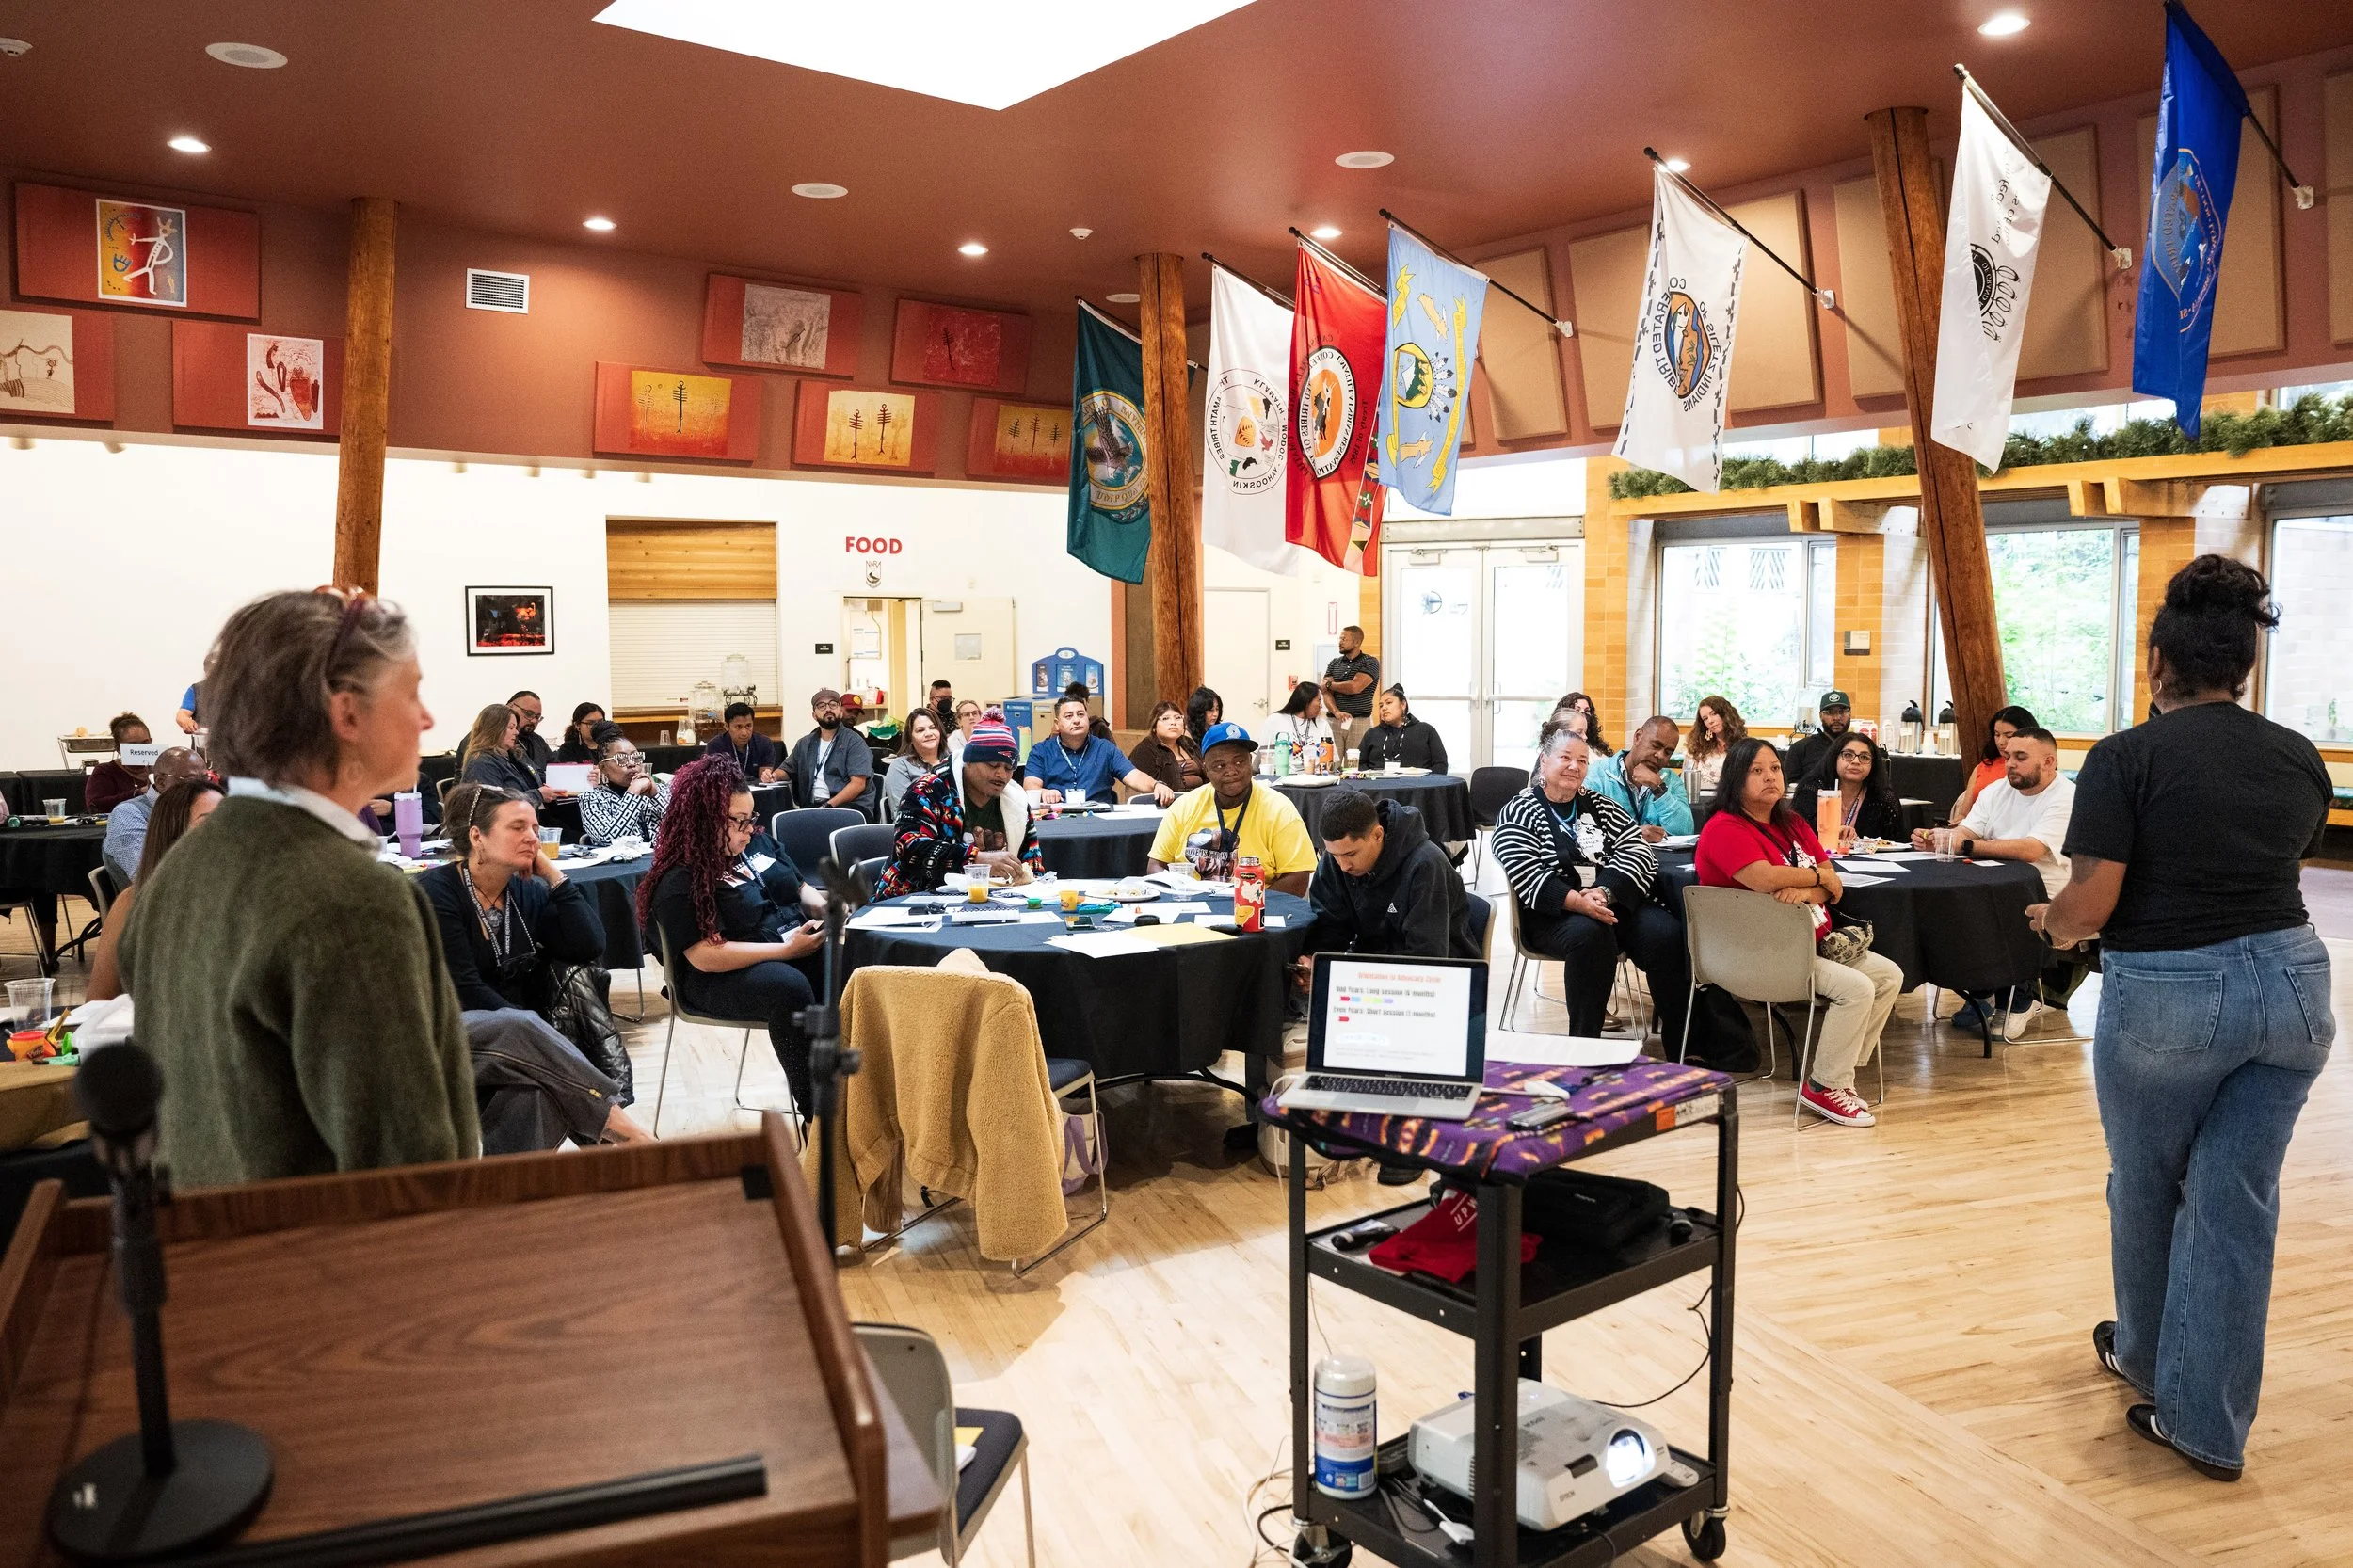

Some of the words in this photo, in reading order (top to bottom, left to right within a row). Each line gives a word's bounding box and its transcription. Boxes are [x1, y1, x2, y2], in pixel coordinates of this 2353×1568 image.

[845, 536, 903, 554] FOOD
[865, 559, 882, 568] NARA
[1453, 1197, 1478, 1226] UPW
